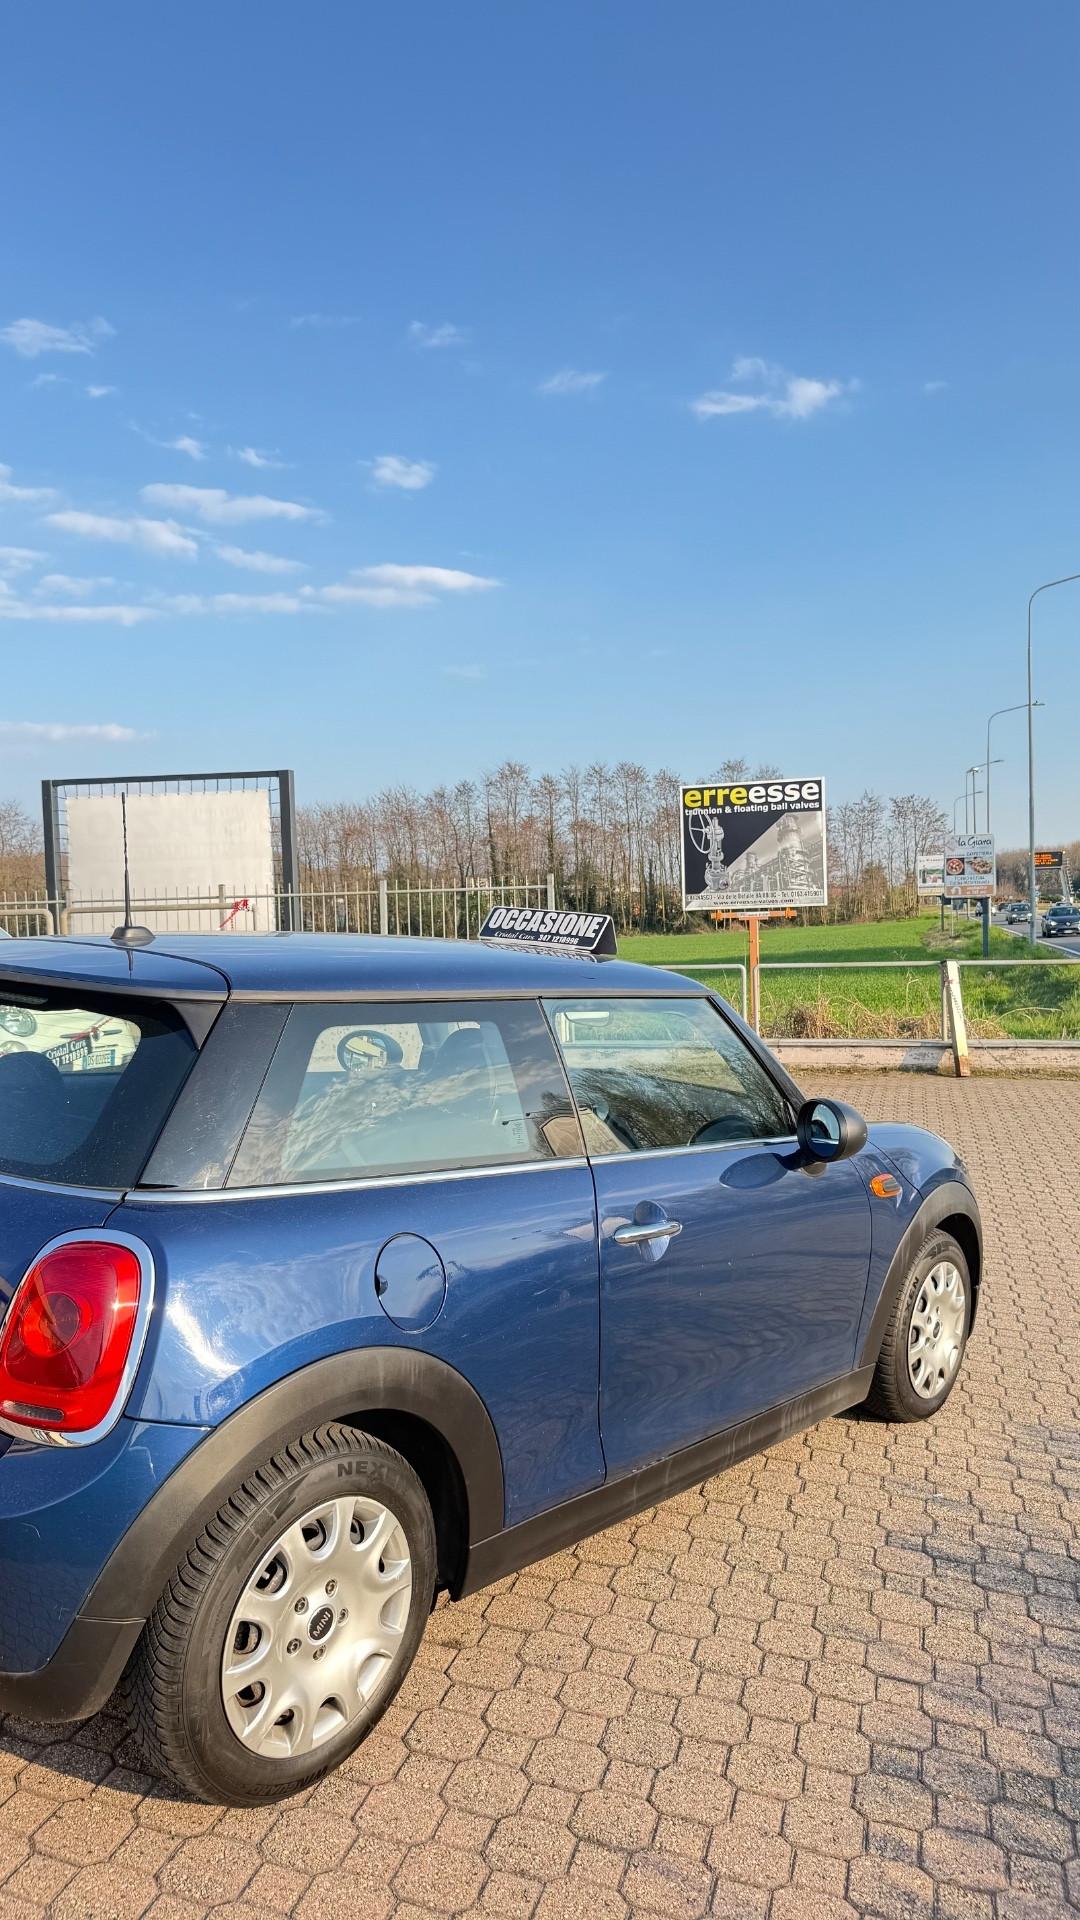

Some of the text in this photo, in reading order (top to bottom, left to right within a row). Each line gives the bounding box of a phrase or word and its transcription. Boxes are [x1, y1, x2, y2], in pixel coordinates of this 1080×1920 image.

[684, 782, 820, 808] erreesse
[724, 805, 732, 814] &
[733, 803, 769, 814] floating
[770, 801, 788, 811] ball
[789, 800, 820, 810] valves
[488, 908, 604, 939] OCCASIONE
[537, 934, 551, 942] 347
[46, 1039, 87, 1060] Cristal Cars
[312, 1610, 332, 1638] MINI
